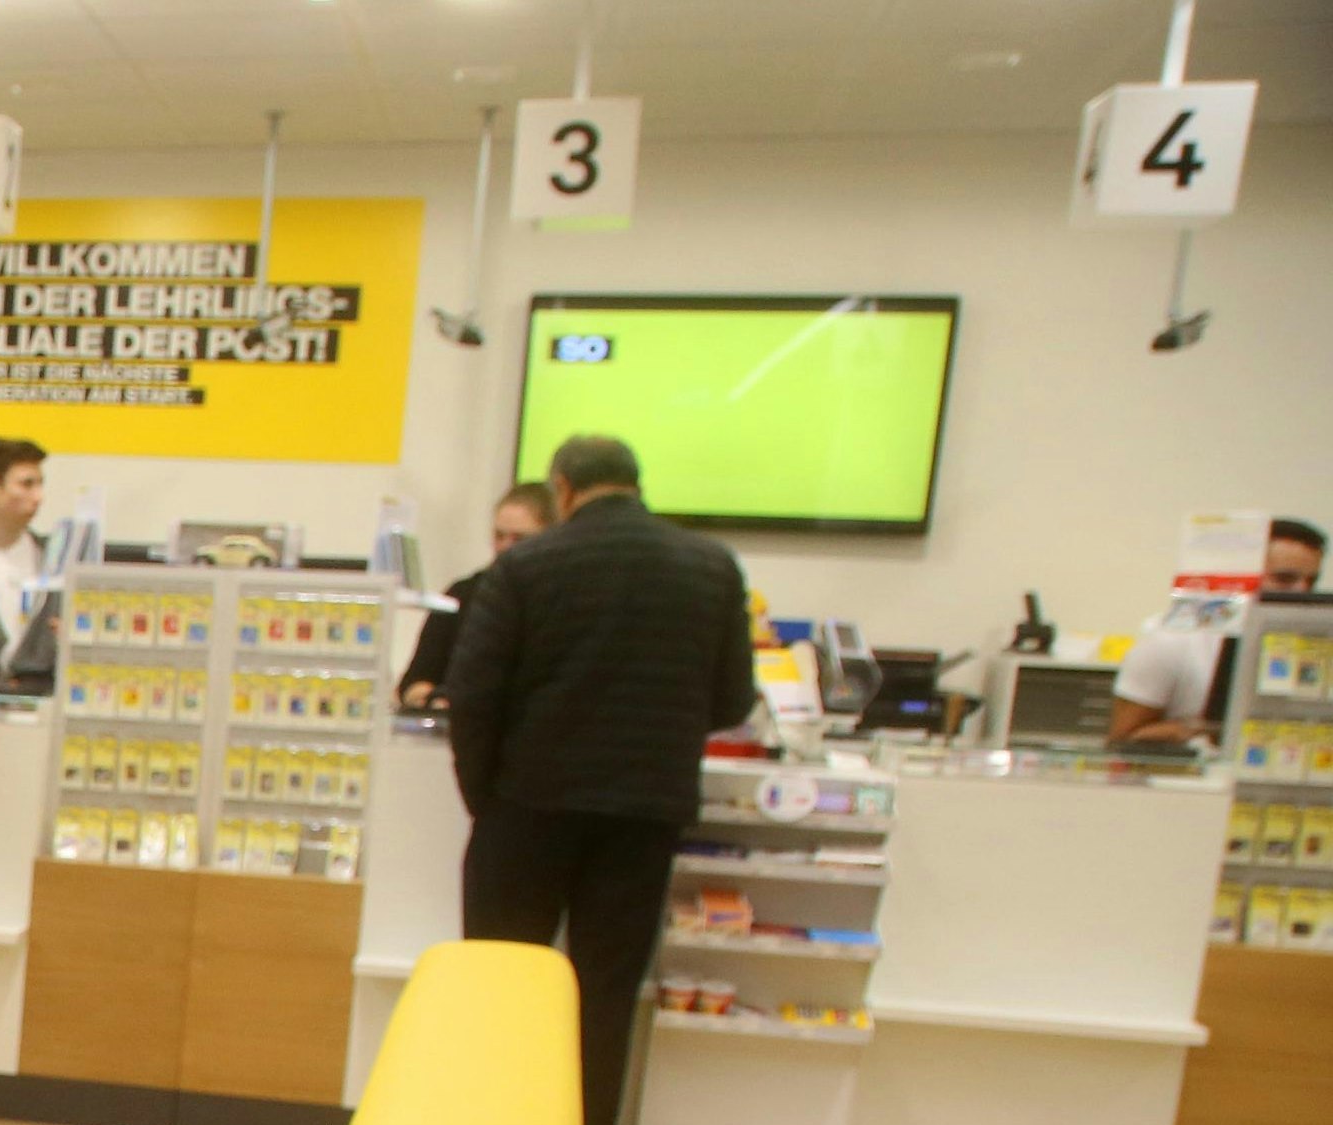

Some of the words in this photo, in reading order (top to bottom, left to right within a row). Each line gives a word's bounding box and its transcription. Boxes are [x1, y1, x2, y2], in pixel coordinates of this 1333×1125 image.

[549, 121, 601, 195] 3
[1139, 110, 1206, 189] 4
[18, 287, 97, 318] DER
[112, 327, 198, 360] DER
